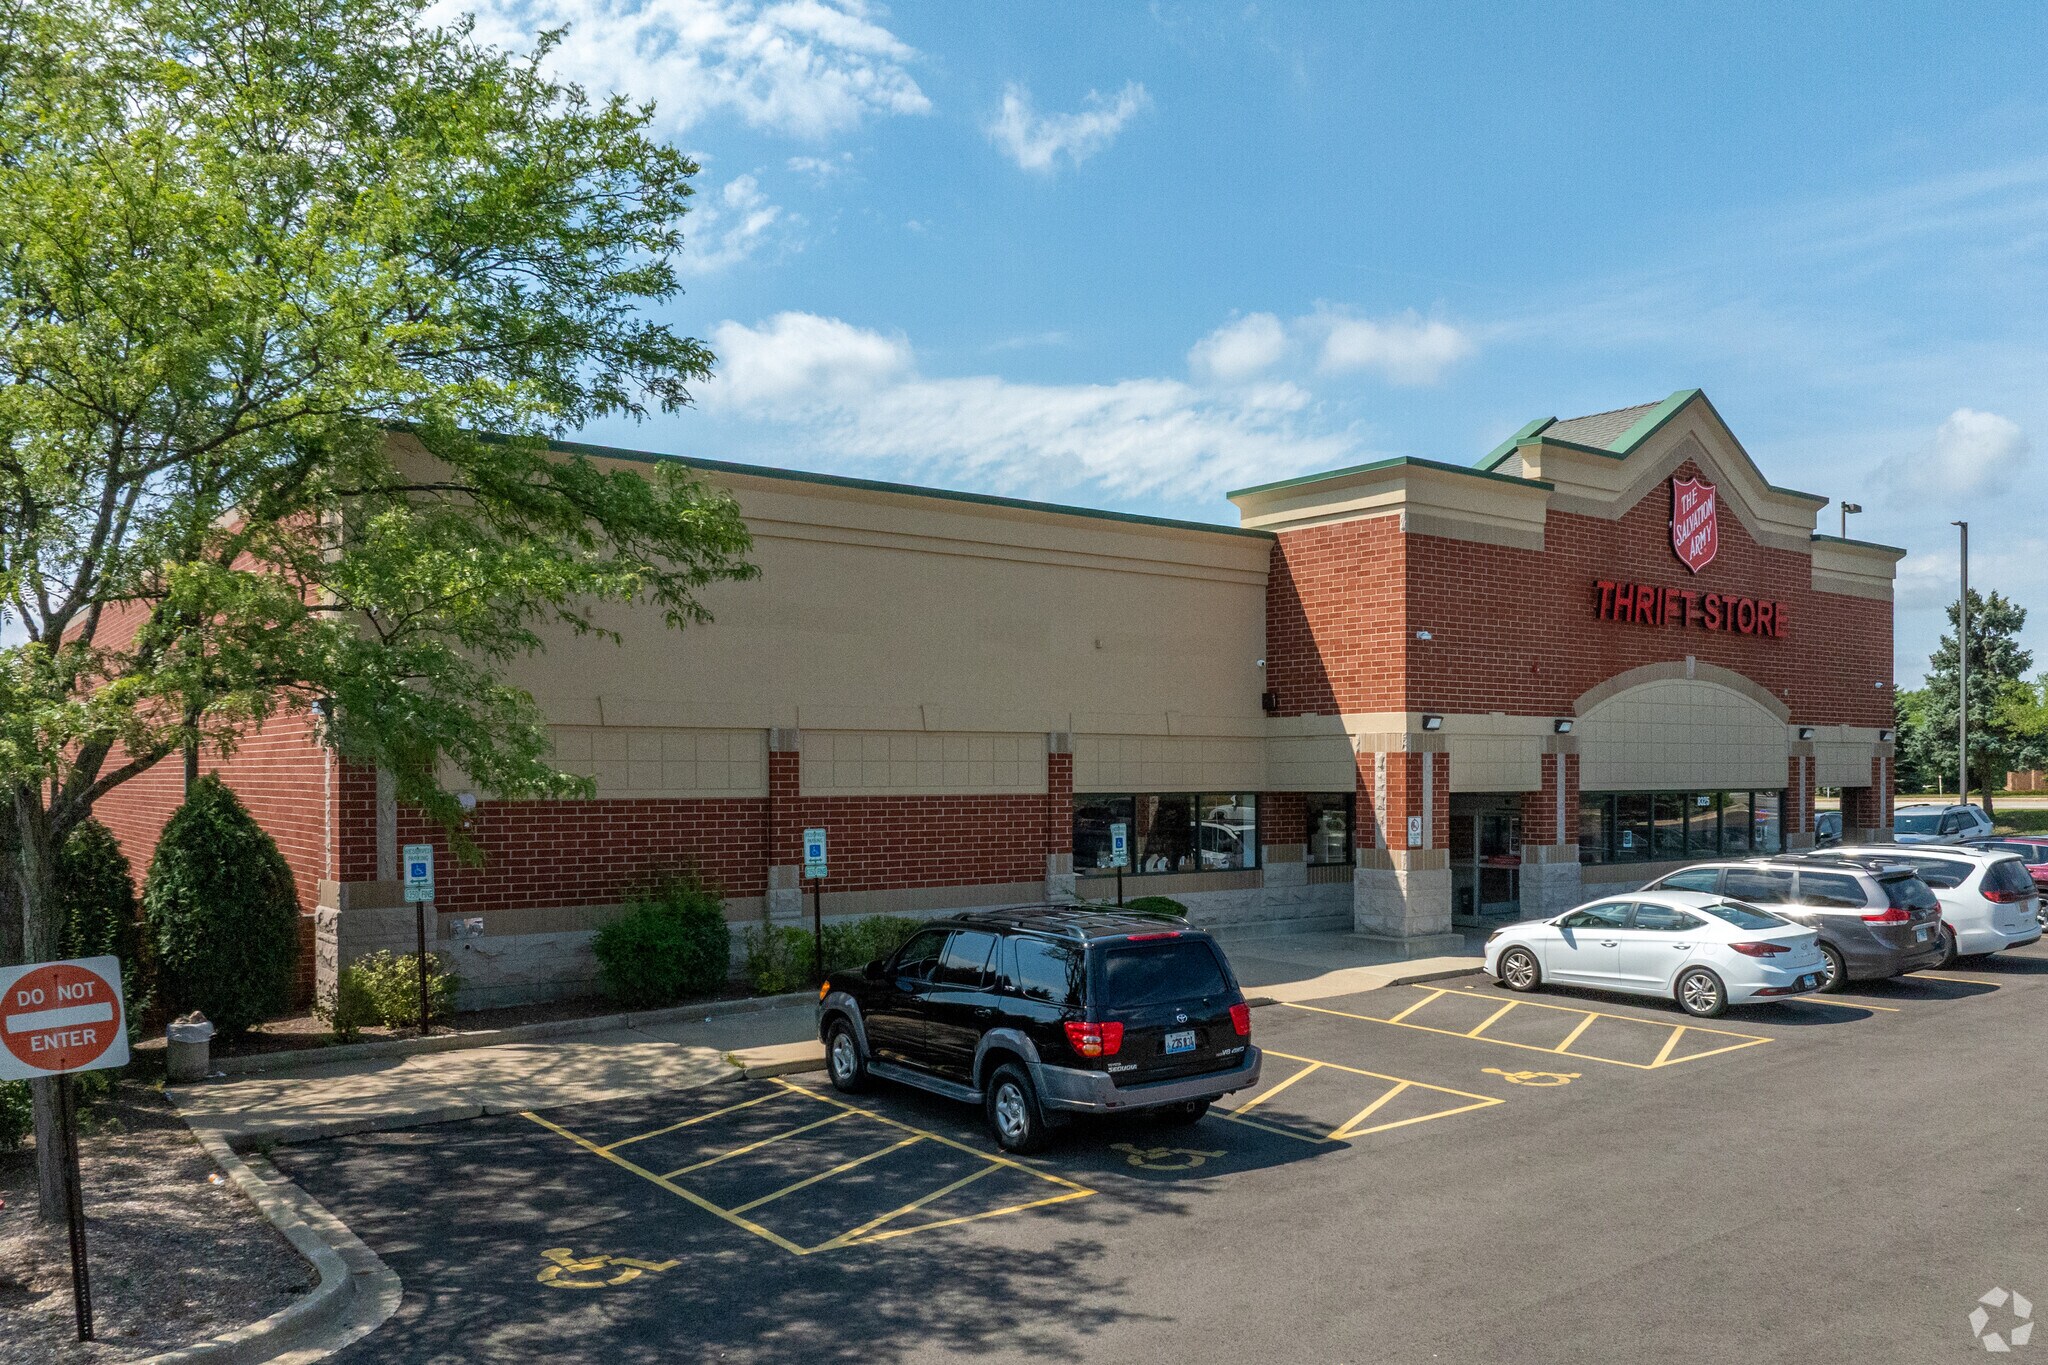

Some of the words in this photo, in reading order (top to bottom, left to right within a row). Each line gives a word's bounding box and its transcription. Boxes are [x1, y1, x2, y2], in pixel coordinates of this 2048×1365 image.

[1681, 487, 1698, 514] THE
[1676, 493, 1713, 546] SALVATION
[1689, 520, 1712, 560] ARMY
[1595, 581, 1696, 627] THRIFT
[1703, 591, 1789, 638] STORE
[17, 988, 45, 1007] DO
[57, 981, 96, 1001] NOT
[31, 1028, 97, 1052] ENTER
